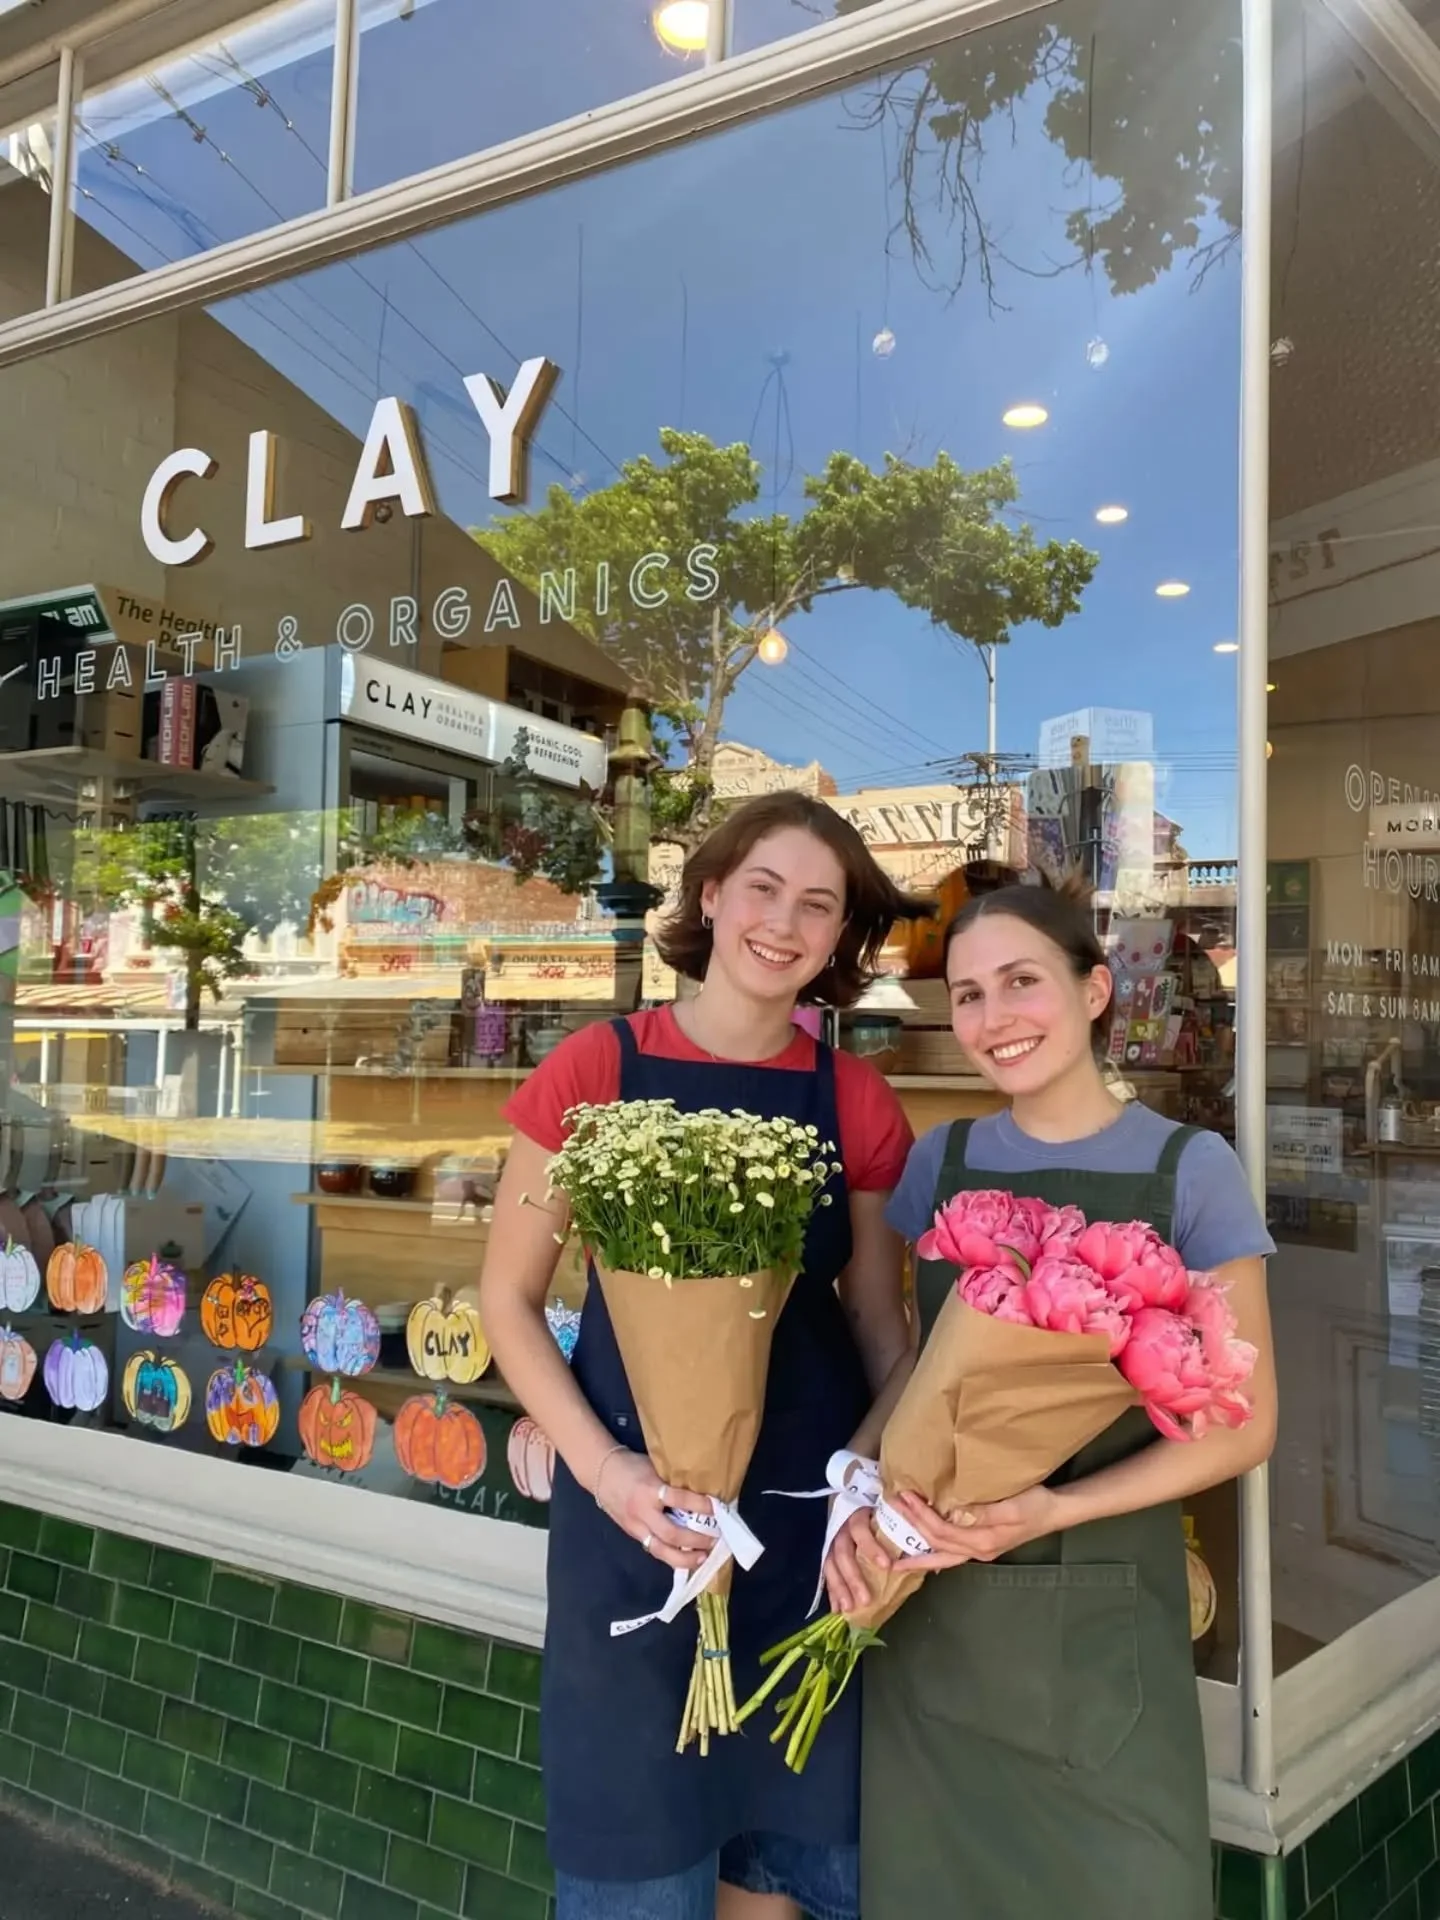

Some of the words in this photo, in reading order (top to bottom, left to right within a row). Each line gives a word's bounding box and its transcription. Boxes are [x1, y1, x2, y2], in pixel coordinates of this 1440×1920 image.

[141, 356, 558, 565] CLAY
[37, 624, 242, 700] HEALTH
[276, 616, 303, 663] &
[337, 543, 721, 652] ORGANICS
[117, 596, 153, 623] The
[366, 680, 432, 719] CLAY
[534, 746, 581, 769] REFRESHING
[563, 743, 584, 758] COOL
[1387, 819, 1440, 833] MOR
[1326, 940, 1363, 968] MON
[1385, 948, 1406, 973] FRI
[1412, 953, 1440, 977] 8AM
[1327, 990, 1355, 1017] SAT
[1362, 994, 1372, 1017] &
[1379, 996, 1407, 1020] SUN
[1412, 998, 1440, 1022] 8AM
[424, 1330, 471, 1357] CLAY
